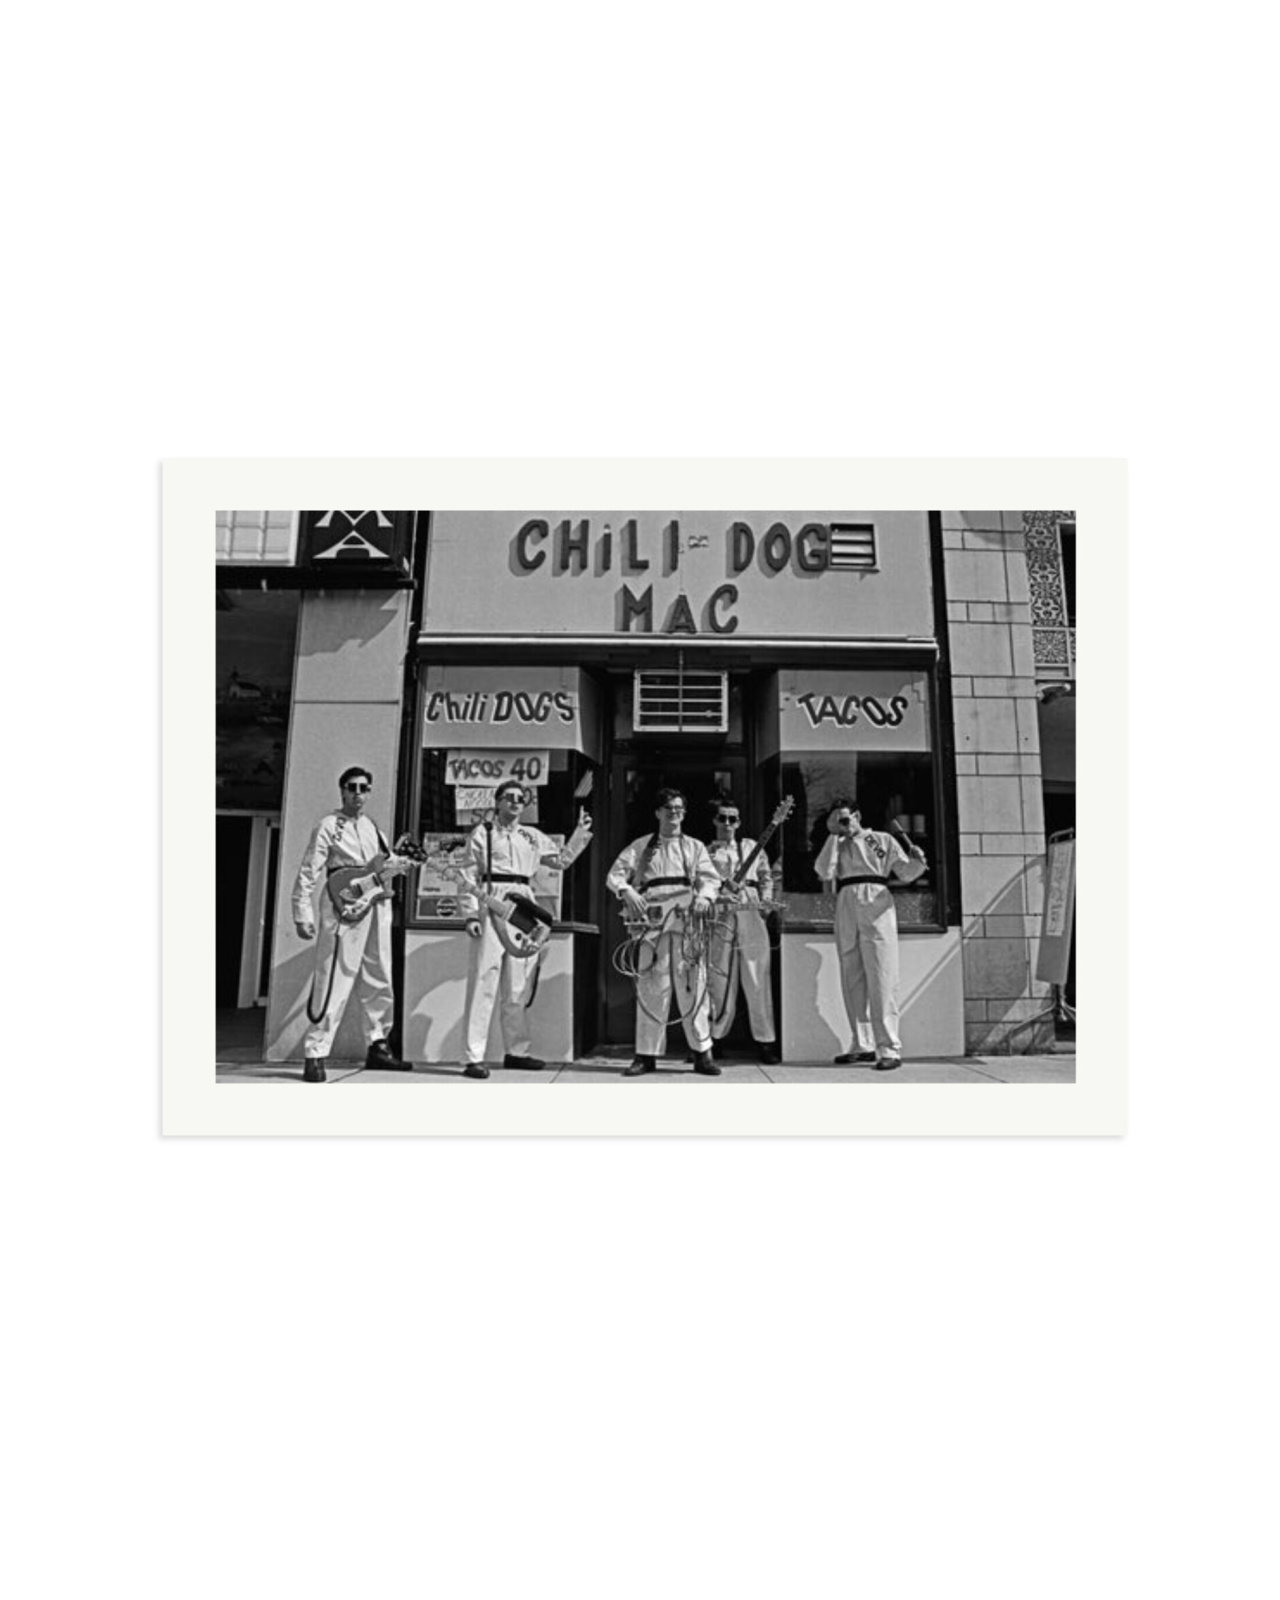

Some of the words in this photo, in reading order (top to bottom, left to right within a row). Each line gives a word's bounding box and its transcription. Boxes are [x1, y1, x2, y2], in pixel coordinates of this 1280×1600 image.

[726, 522, 829, 578] DOG
[615, 584, 738, 633] MAC
[492, 691, 575, 723] DOGS
[797, 692, 908, 727] TACOS
[449, 759, 504, 780] TACOS
